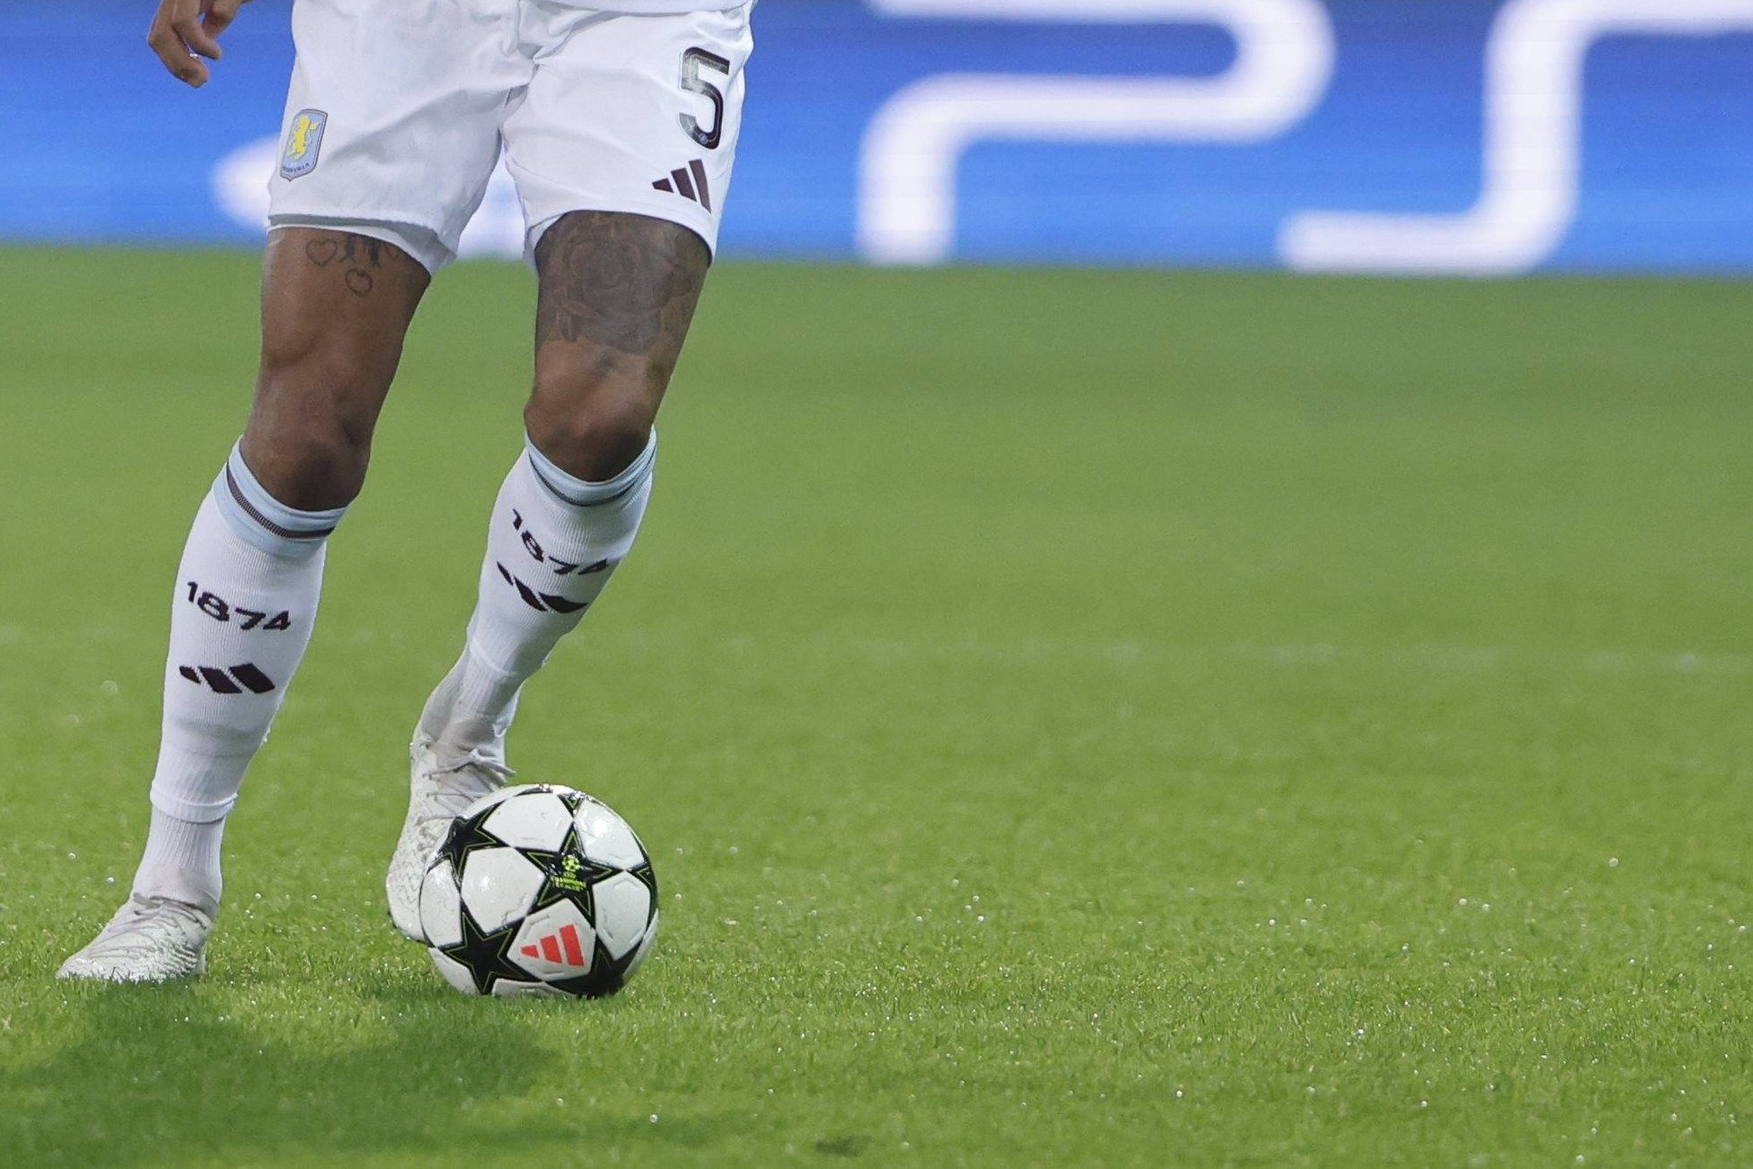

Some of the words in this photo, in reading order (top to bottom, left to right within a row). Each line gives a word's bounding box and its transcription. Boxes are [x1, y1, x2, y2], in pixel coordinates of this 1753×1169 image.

[679, 46, 730, 150] 5
[512, 508, 609, 576] 1874
[187, 581, 291, 631] 1874
